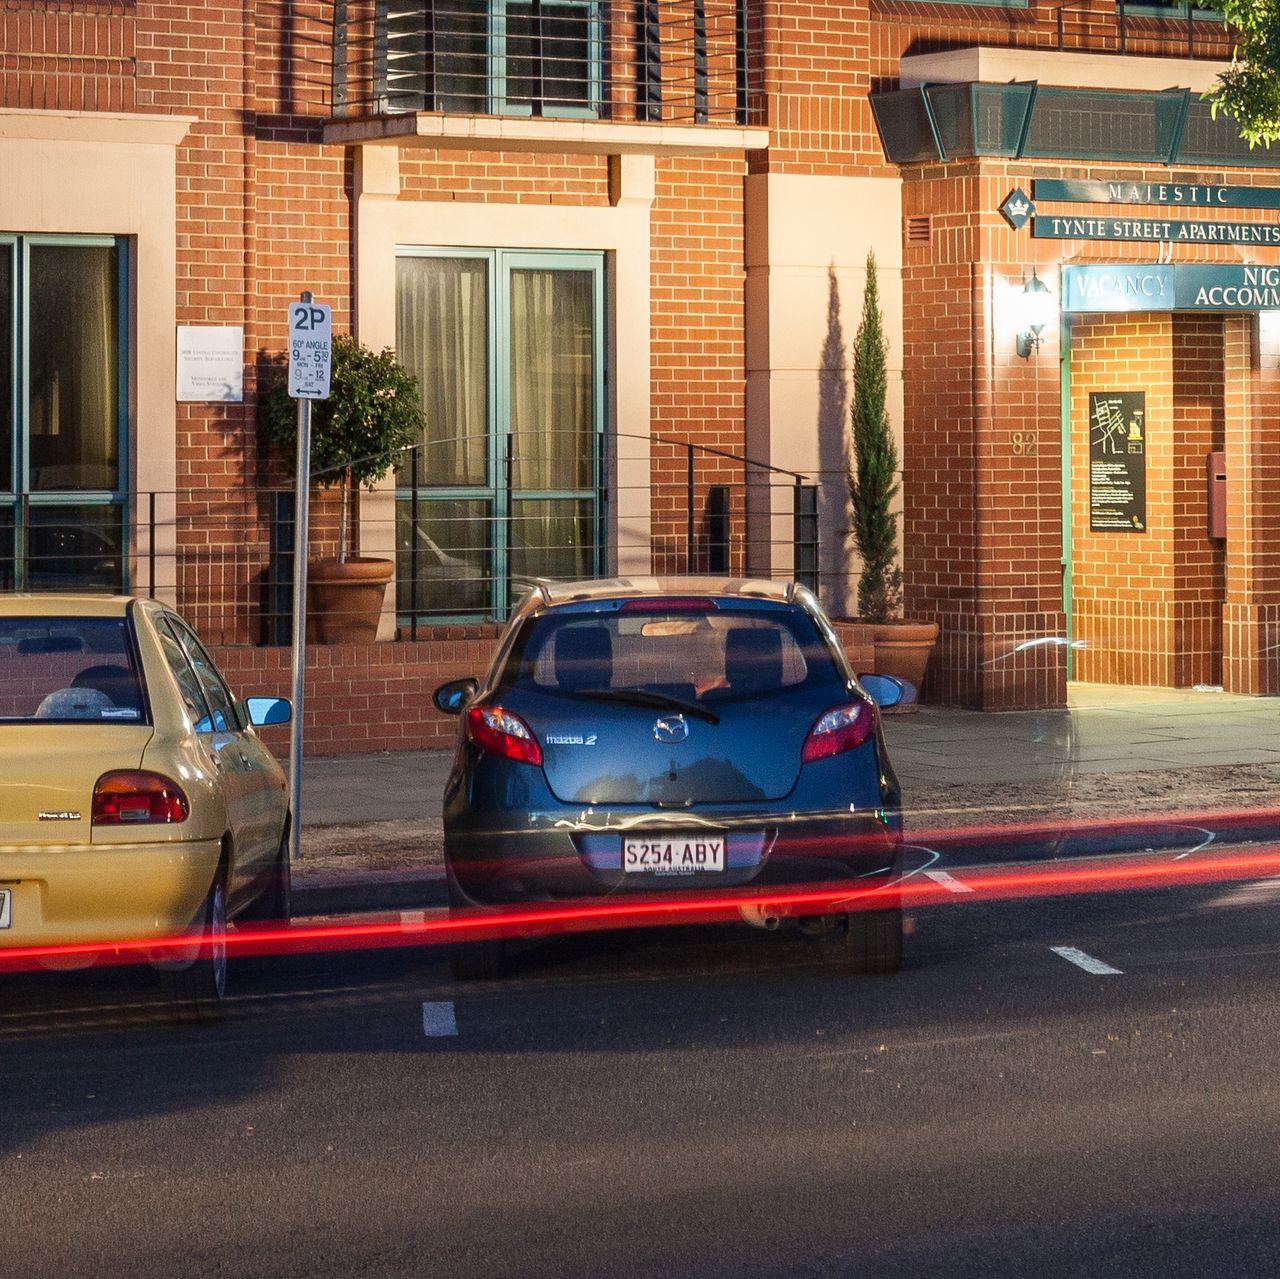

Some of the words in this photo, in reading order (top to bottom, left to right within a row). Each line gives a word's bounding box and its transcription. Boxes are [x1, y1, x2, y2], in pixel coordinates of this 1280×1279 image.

[1109, 184, 1228, 203] MAJESTIC
[1052, 219, 1106, 236] TYNTE
[1113, 221, 1171, 238] STREET
[1178, 224, 1280, 242] APARTMENTS
[1076, 275, 1167, 297] VACANCY
[294, 307, 325, 330] 2P
[306, 341, 328, 351] ANGLE
[1012, 432, 1037, 456] 82
